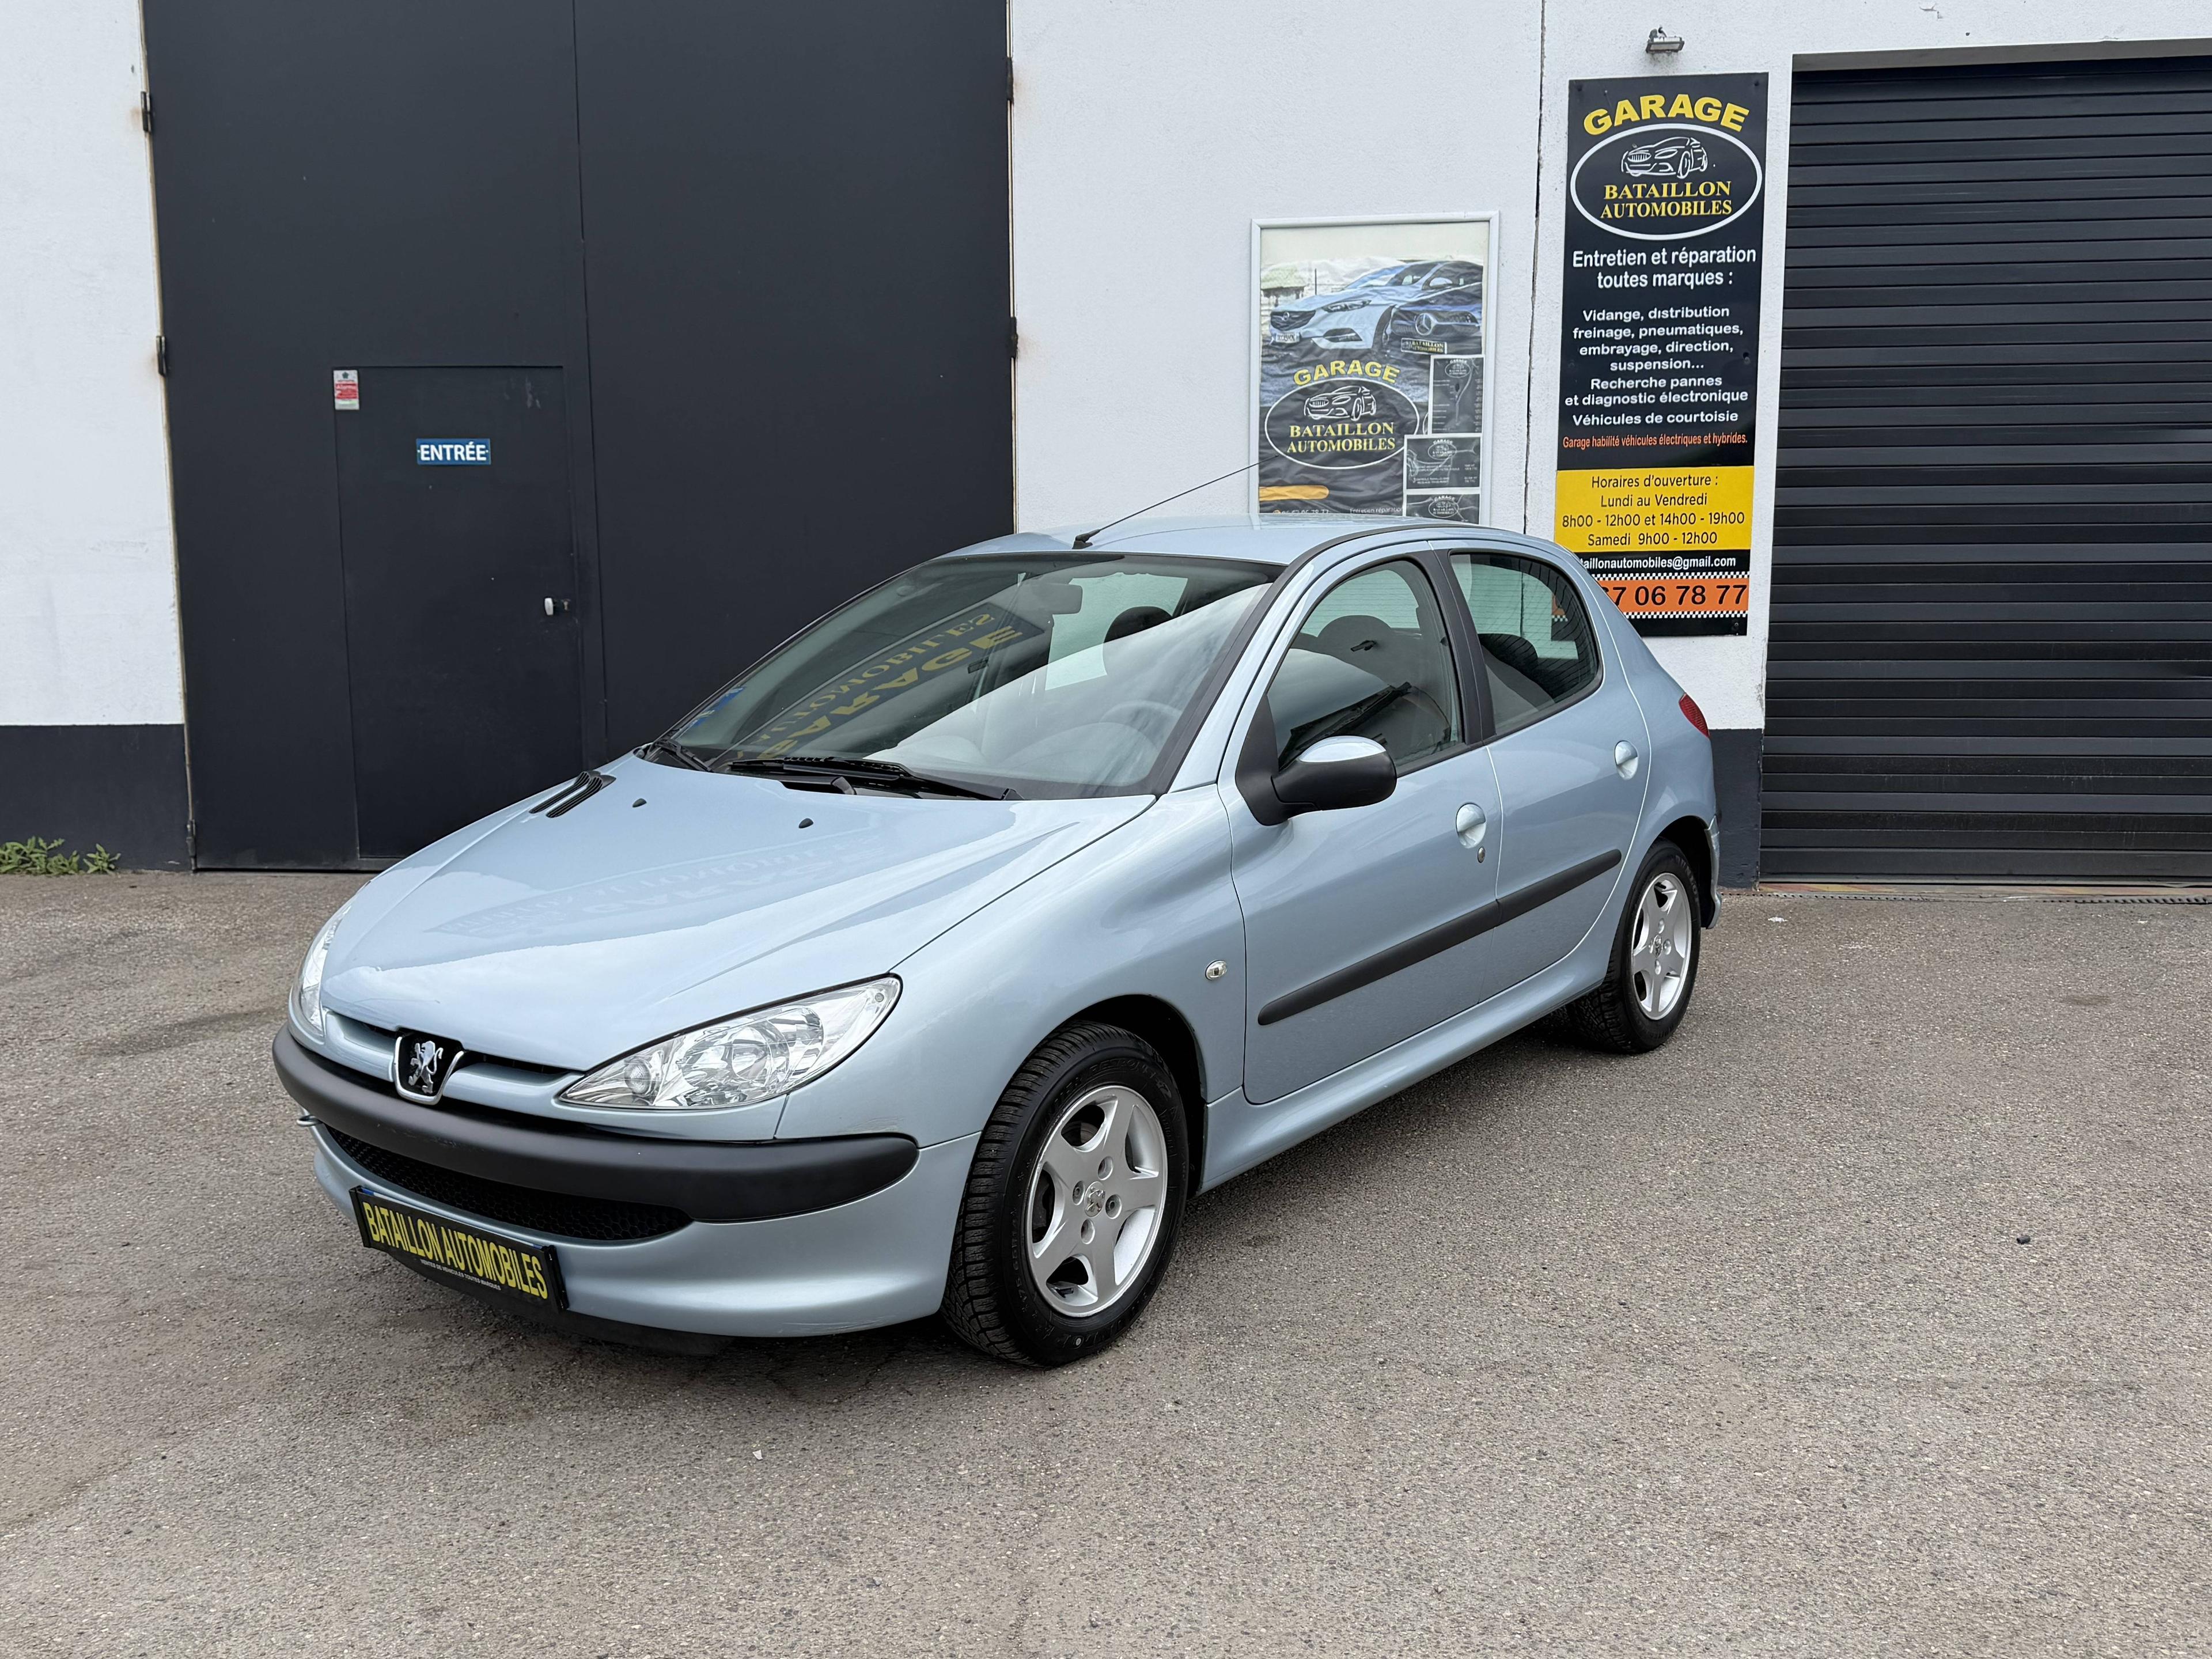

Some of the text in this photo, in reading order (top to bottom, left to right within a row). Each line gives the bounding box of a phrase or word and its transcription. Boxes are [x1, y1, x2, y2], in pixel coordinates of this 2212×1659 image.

[1584, 94, 1749, 135] GARAGE
[1604, 181, 1732, 199] BATAILLON
[1600, 200, 1732, 218] AUTOMOBILES
[1573, 246, 1756, 267] Entretien et réparation
[1597, 271, 1733, 289] toutes marques :
[1583, 306, 1730, 323] Vidange, distribution
[1573, 324, 1744, 340] freinage, pneumatiques,
[1580, 340, 1734, 357] embrayage, direction,
[1293, 359, 1402, 386] GARAGE
[1610, 358, 1705, 373] suspension...
[1590, 377, 1722, 389] Recherche pannes
[1565, 391, 1748, 407] et diagnostic électronique
[1573, 411, 1738, 426] Véhicules de courtoisie
[1289, 422, 1395, 438] BATAILLON
[1286, 438, 1396, 453] AUTOMOBILES
[1563, 432, 1748, 450] Garage habilité véhicules électriques et hybrides.
[420, 441, 487, 461] ENTRÉE
[1592, 475, 1639, 488] Horaires
[1601, 493, 1707, 507] Lundi au Vendredi
[1562, 514, 1593, 528] 8h00
[1605, 514, 1640, 527] 12h00
[1645, 514, 1656, 525] et
[1660, 513, 1696, 525] 14h00
[1709, 512, 1745, 524] 19h00
[1588, 533, 1631, 546] Samedi
[1638, 532, 1669, 545] 9h00
[1682, 532, 1717, 544] 12h00
[1603, 585, 1748, 606] 7 06 78 77
[363, 1202, 548, 1300] BATAILLON AUTOMOBILES
